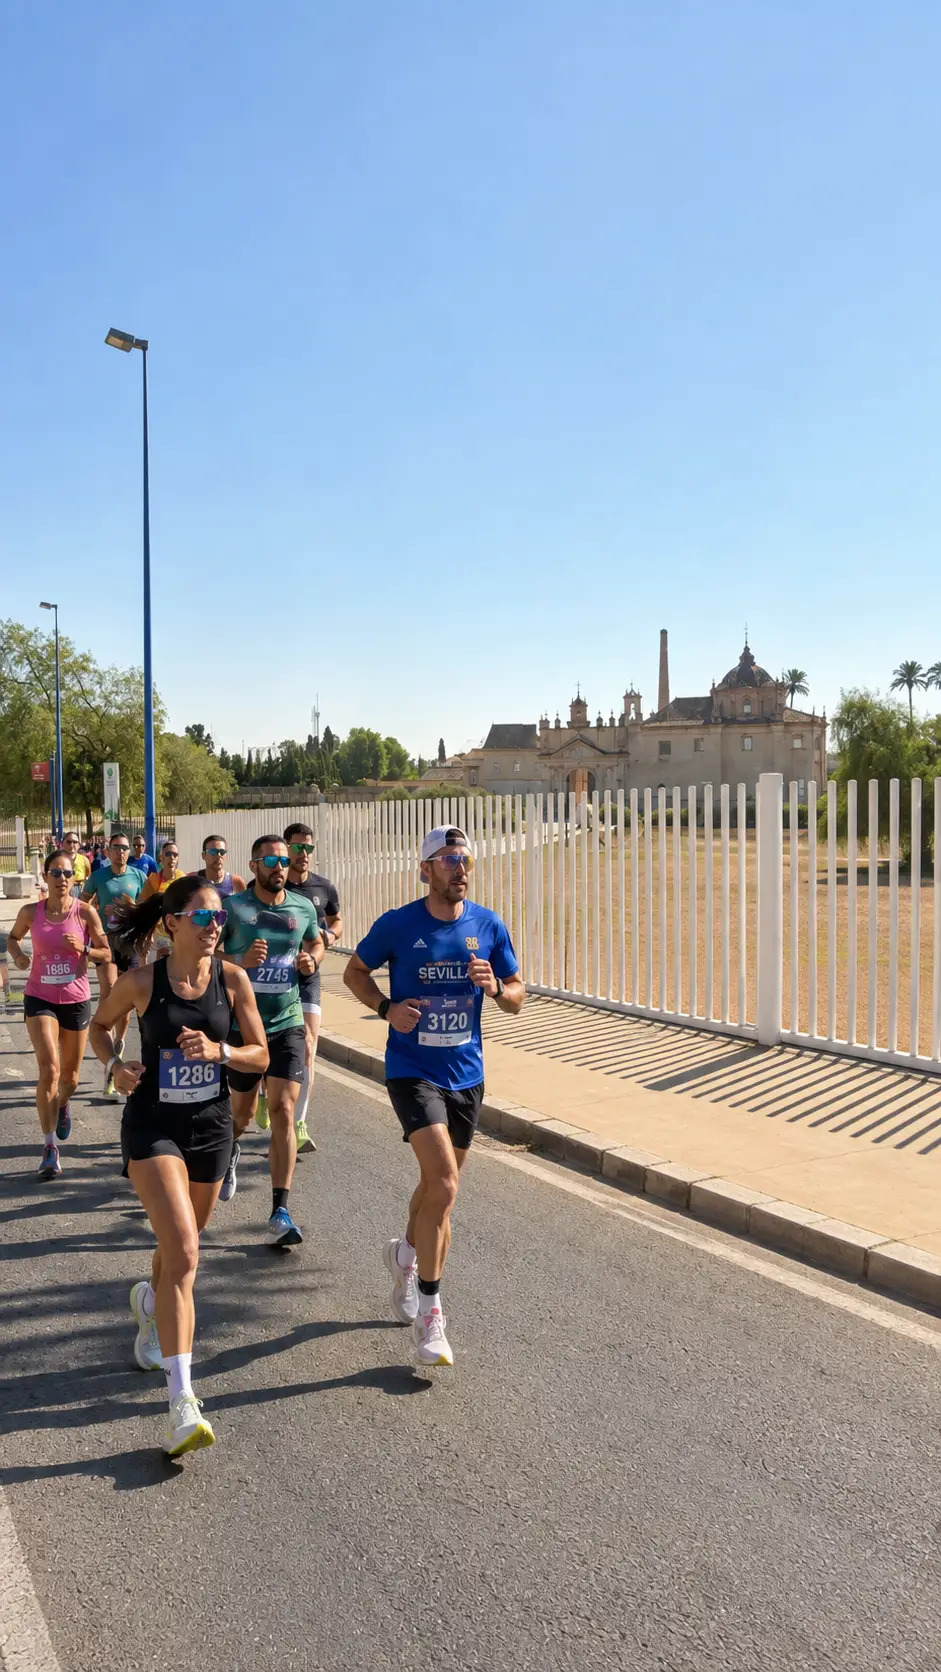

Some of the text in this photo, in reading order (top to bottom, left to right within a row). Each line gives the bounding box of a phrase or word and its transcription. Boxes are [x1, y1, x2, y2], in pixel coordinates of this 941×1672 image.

[256, 967, 289, 982] 2745
[427, 1012, 468, 1031] 3120
[168, 1063, 215, 1086] 1286
